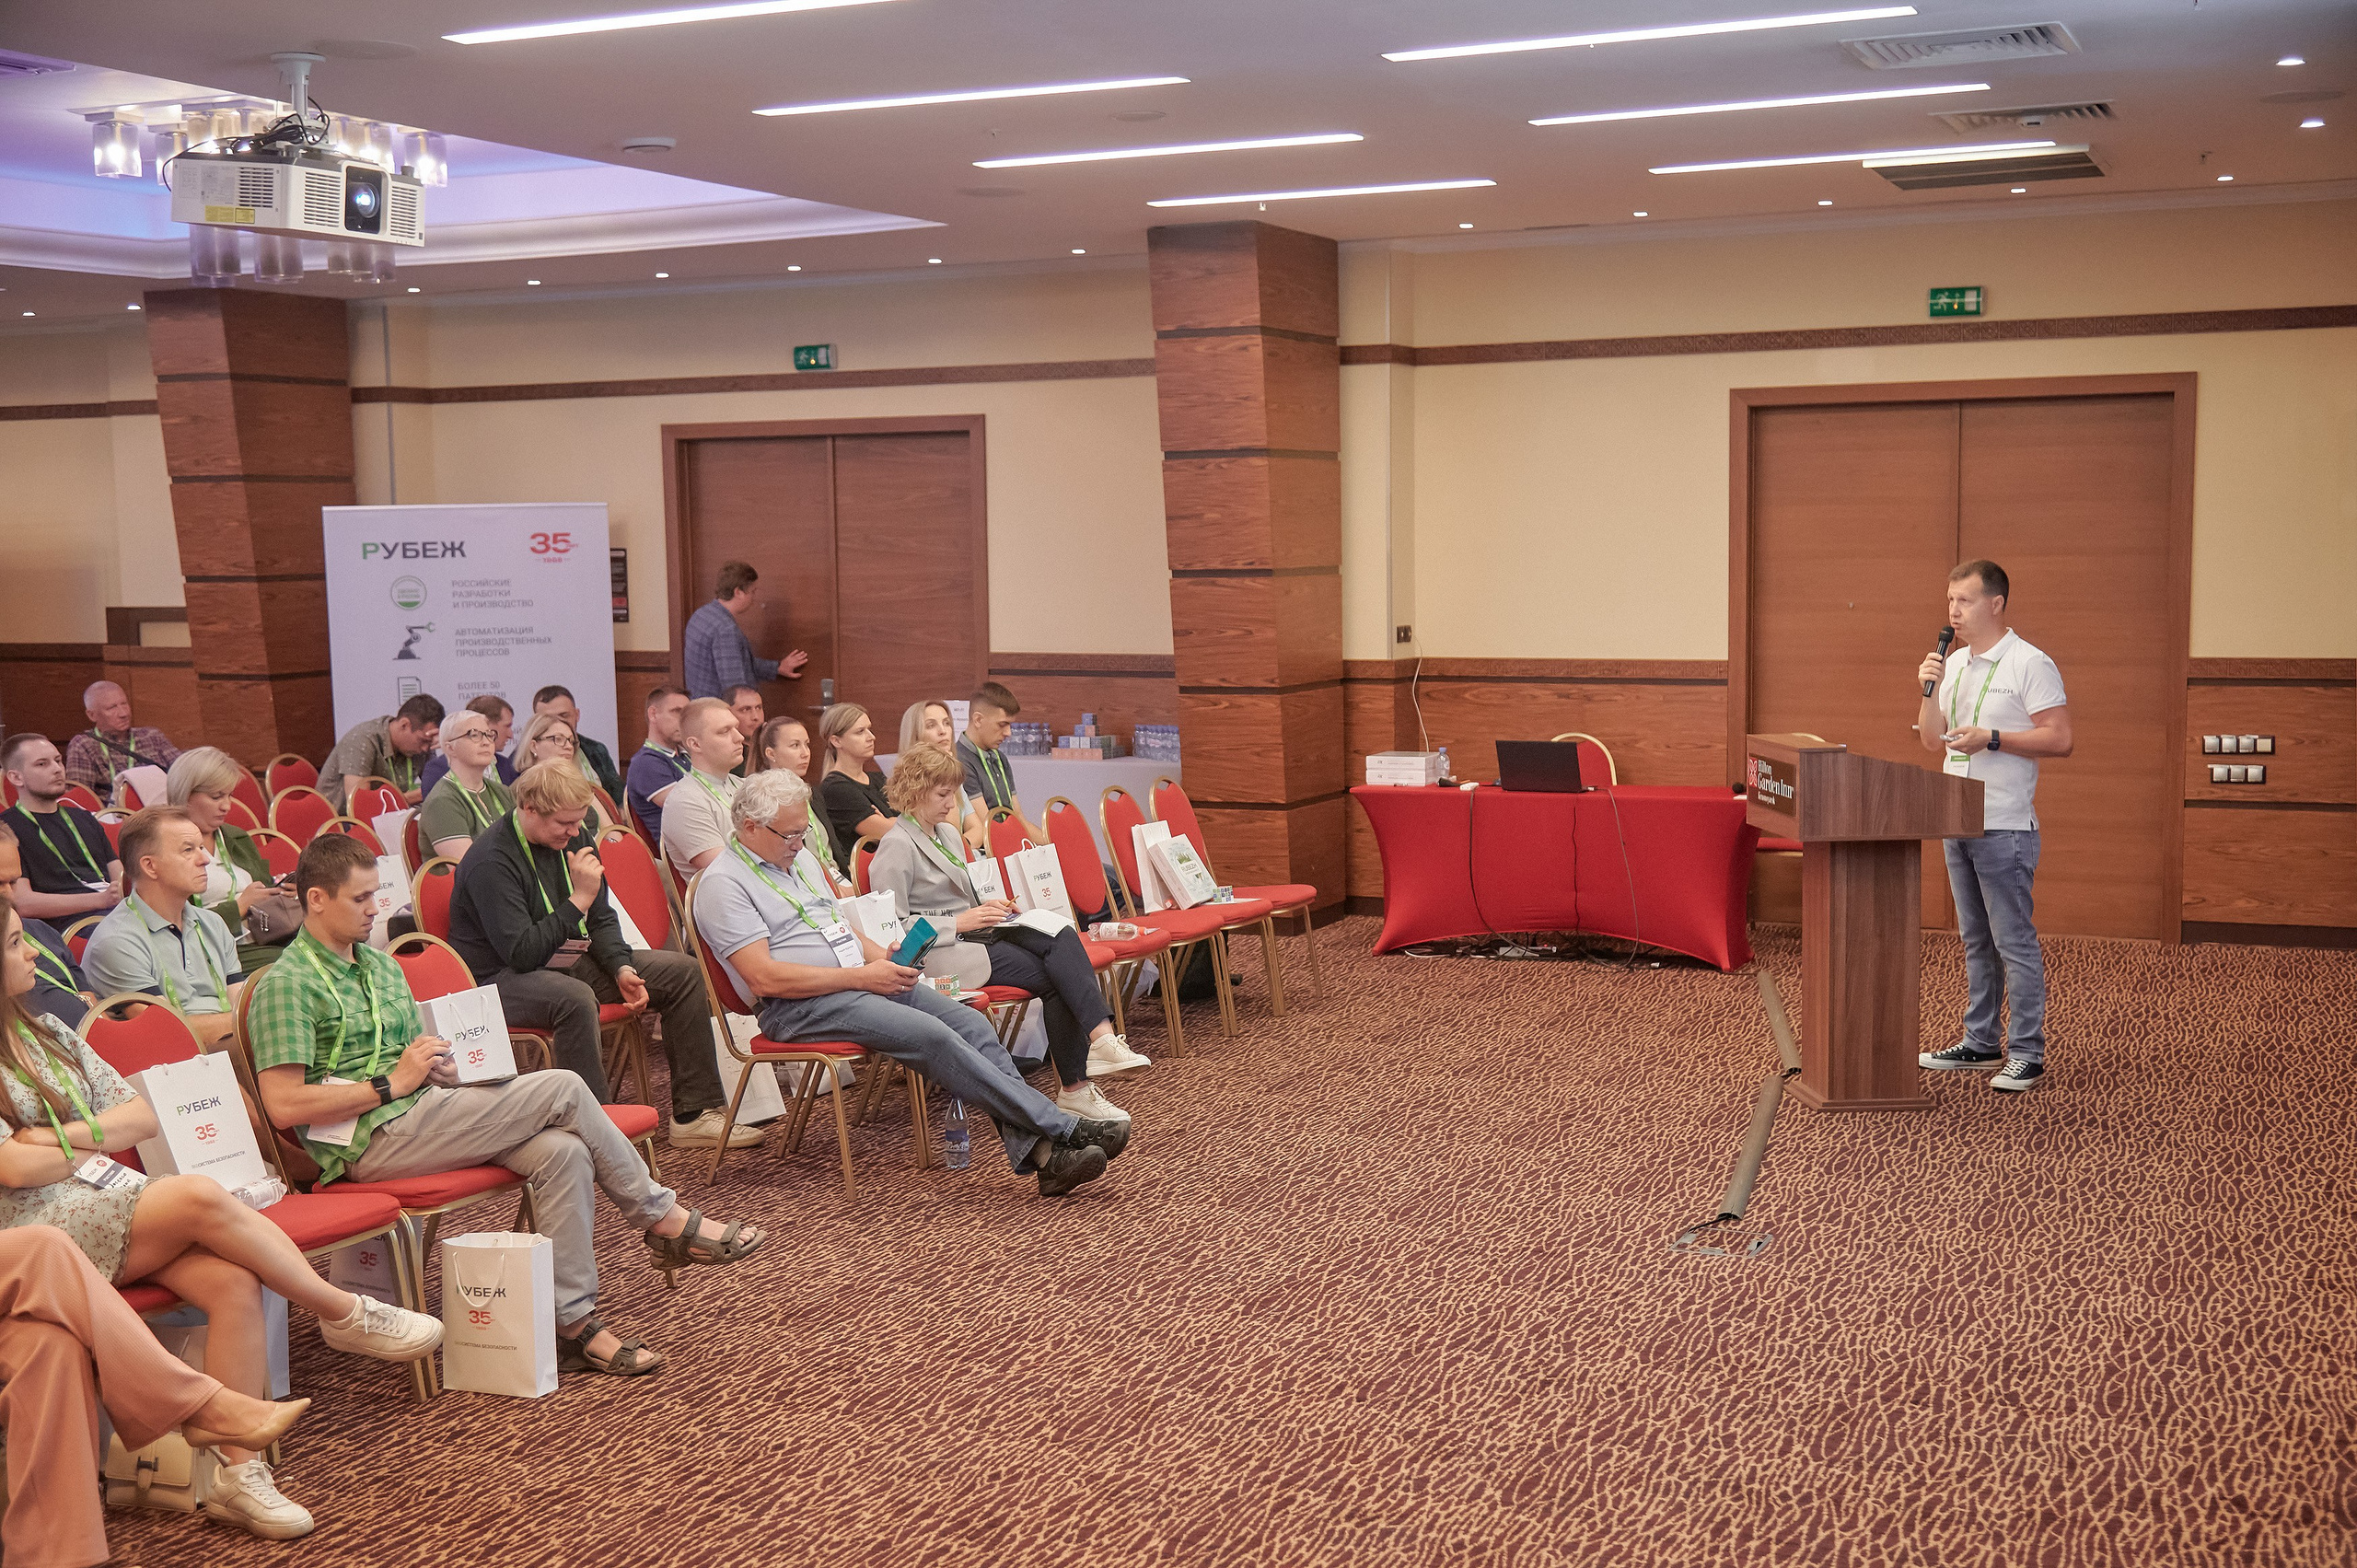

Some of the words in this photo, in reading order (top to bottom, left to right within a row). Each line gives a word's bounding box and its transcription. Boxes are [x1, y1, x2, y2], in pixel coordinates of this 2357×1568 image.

[530, 532, 572, 554] 35
[362, 540, 467, 560] РУБЕЖ
[451, 578, 512, 587] РОССИЙСКИЕ
[452, 589, 511, 598] РАЗРАБОТКИ
[453, 601, 460, 610] И
[462, 599, 534, 610] ПРОИЗВОДСТВО
[455, 626, 534, 636] АВТОМАТИЗАЦИЯ
[455, 636, 552, 647] ПРОИЗВОДСТВЕННЫХ
[456, 648, 510, 657] ПРОЦЕССОВ
[458, 681, 487, 691] БОЛЕЕ
[1758, 759, 1772, 775] Hilton
[1758, 772, 1781, 795] Garden
[1033, 870, 1052, 882] РУБЕЖ
[378, 881, 395, 889] БЕЖ
[1041, 887, 1051, 898] 35
[378, 898, 390, 908] 35
[468, 1049, 484, 1064] 35
[67, 1085, 85, 1108] RUBEZH
[176, 1096, 222, 1116] РУБЕЖ
[194, 1122, 217, 1141] 35
[215, 1151, 246, 1162] БЕЗОПАСНОСТИ
[359, 1251, 377, 1267] 35
[469, 1309, 492, 1325] 35
